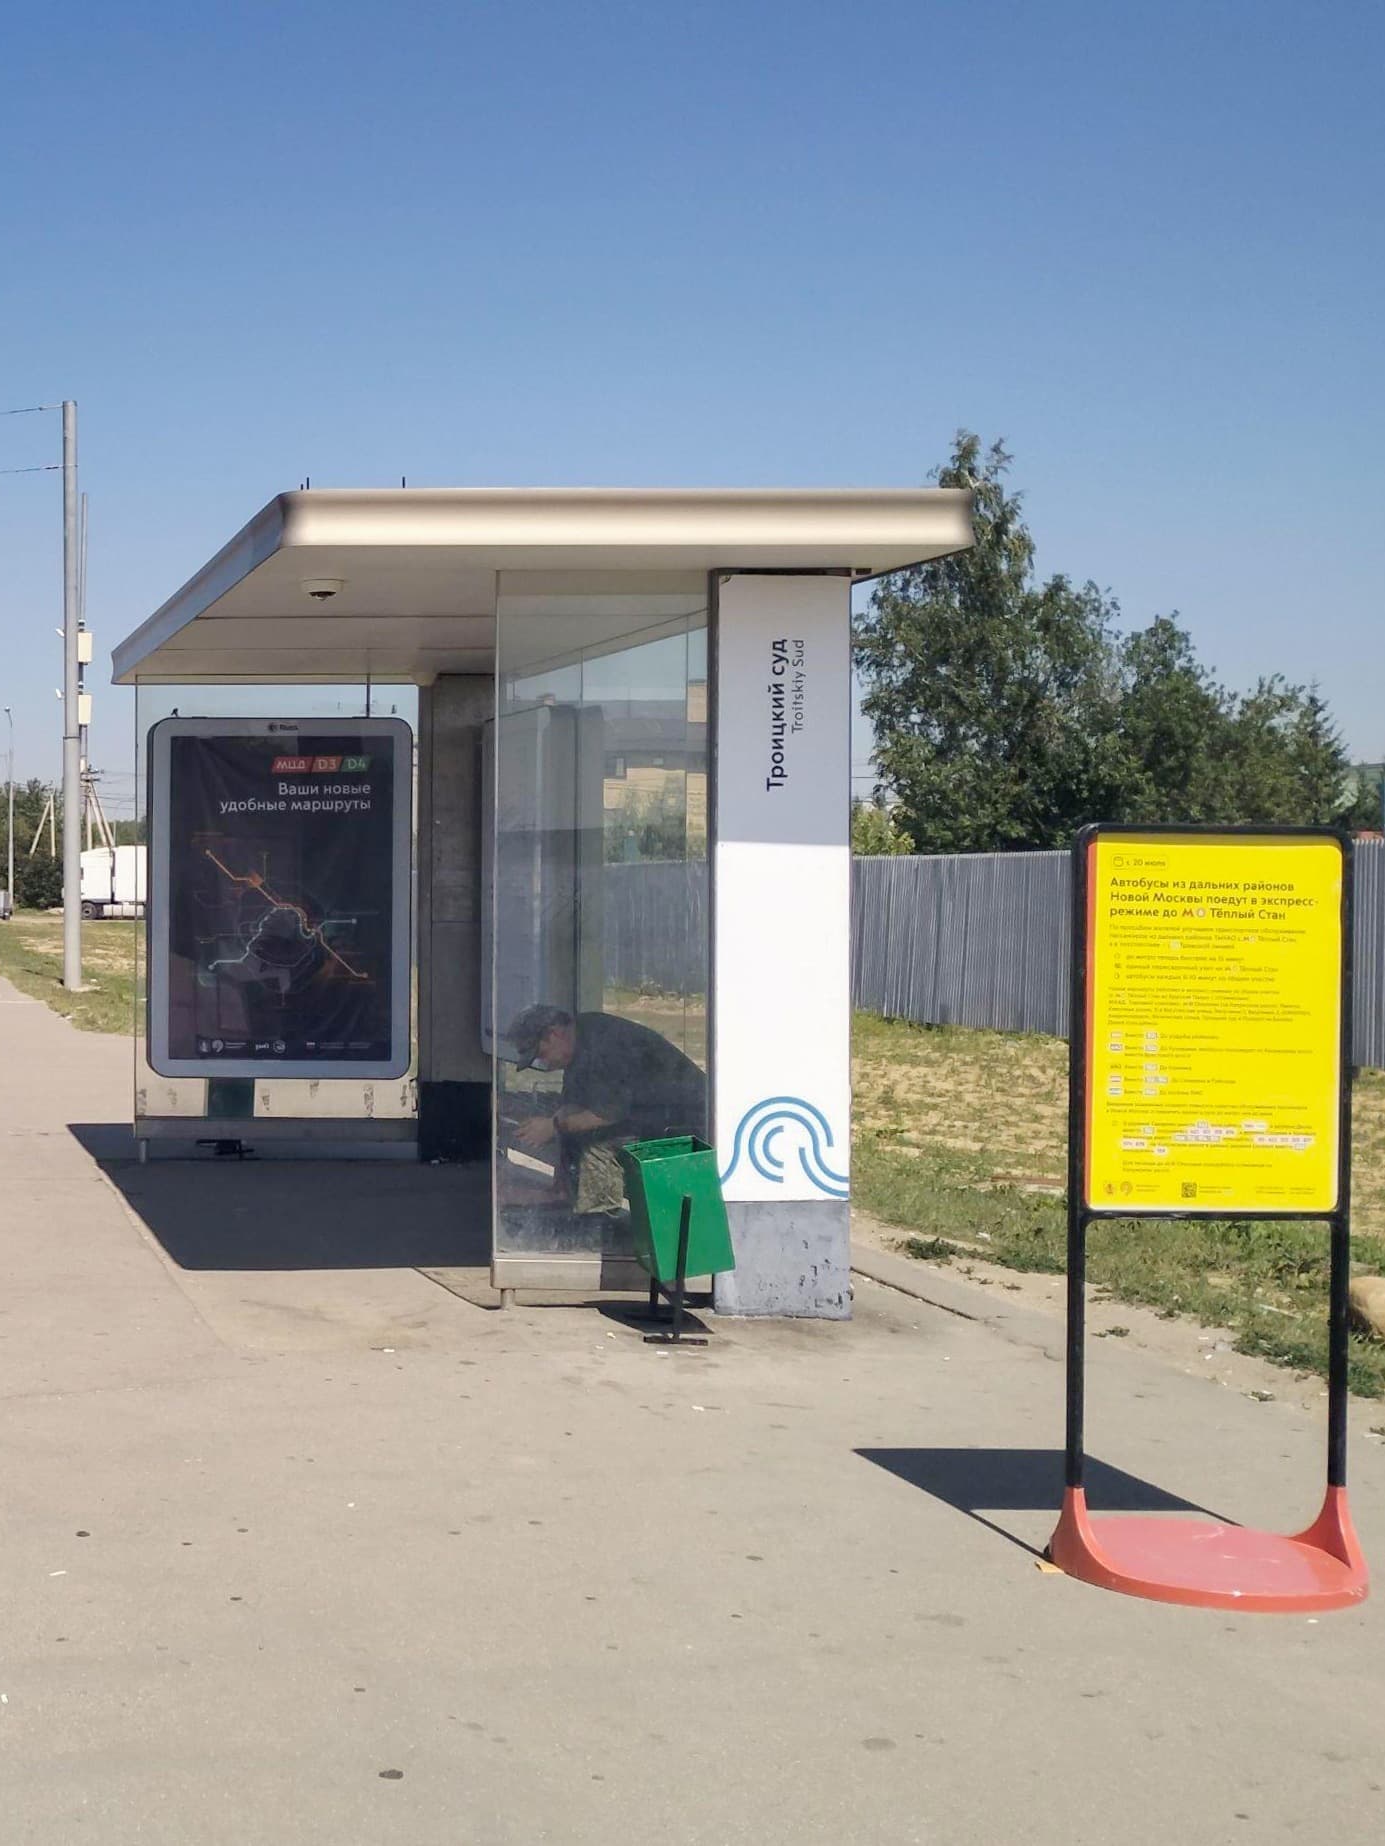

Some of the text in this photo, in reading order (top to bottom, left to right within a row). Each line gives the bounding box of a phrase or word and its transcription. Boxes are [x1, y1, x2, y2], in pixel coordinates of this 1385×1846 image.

[791, 639, 806, 734] Troitskiy Sud
[766, 638, 789, 792] Троицкий суд
[276, 758, 366, 770] МЦД D3 D4
[278, 782, 371, 796] Ваши новые
[219, 798, 371, 814] удобные маршруты
[1110, 877, 1295, 893] Автобусы из дальних районов
[1110, 892, 1319, 908] Новой Москвы поедут в экспресс-
[1109, 908, 1160, 919] режиме
[1162, 908, 1178, 919] до
[1210, 909, 1255, 920] Тёплый
[1258, 910, 1286, 921] Стан
